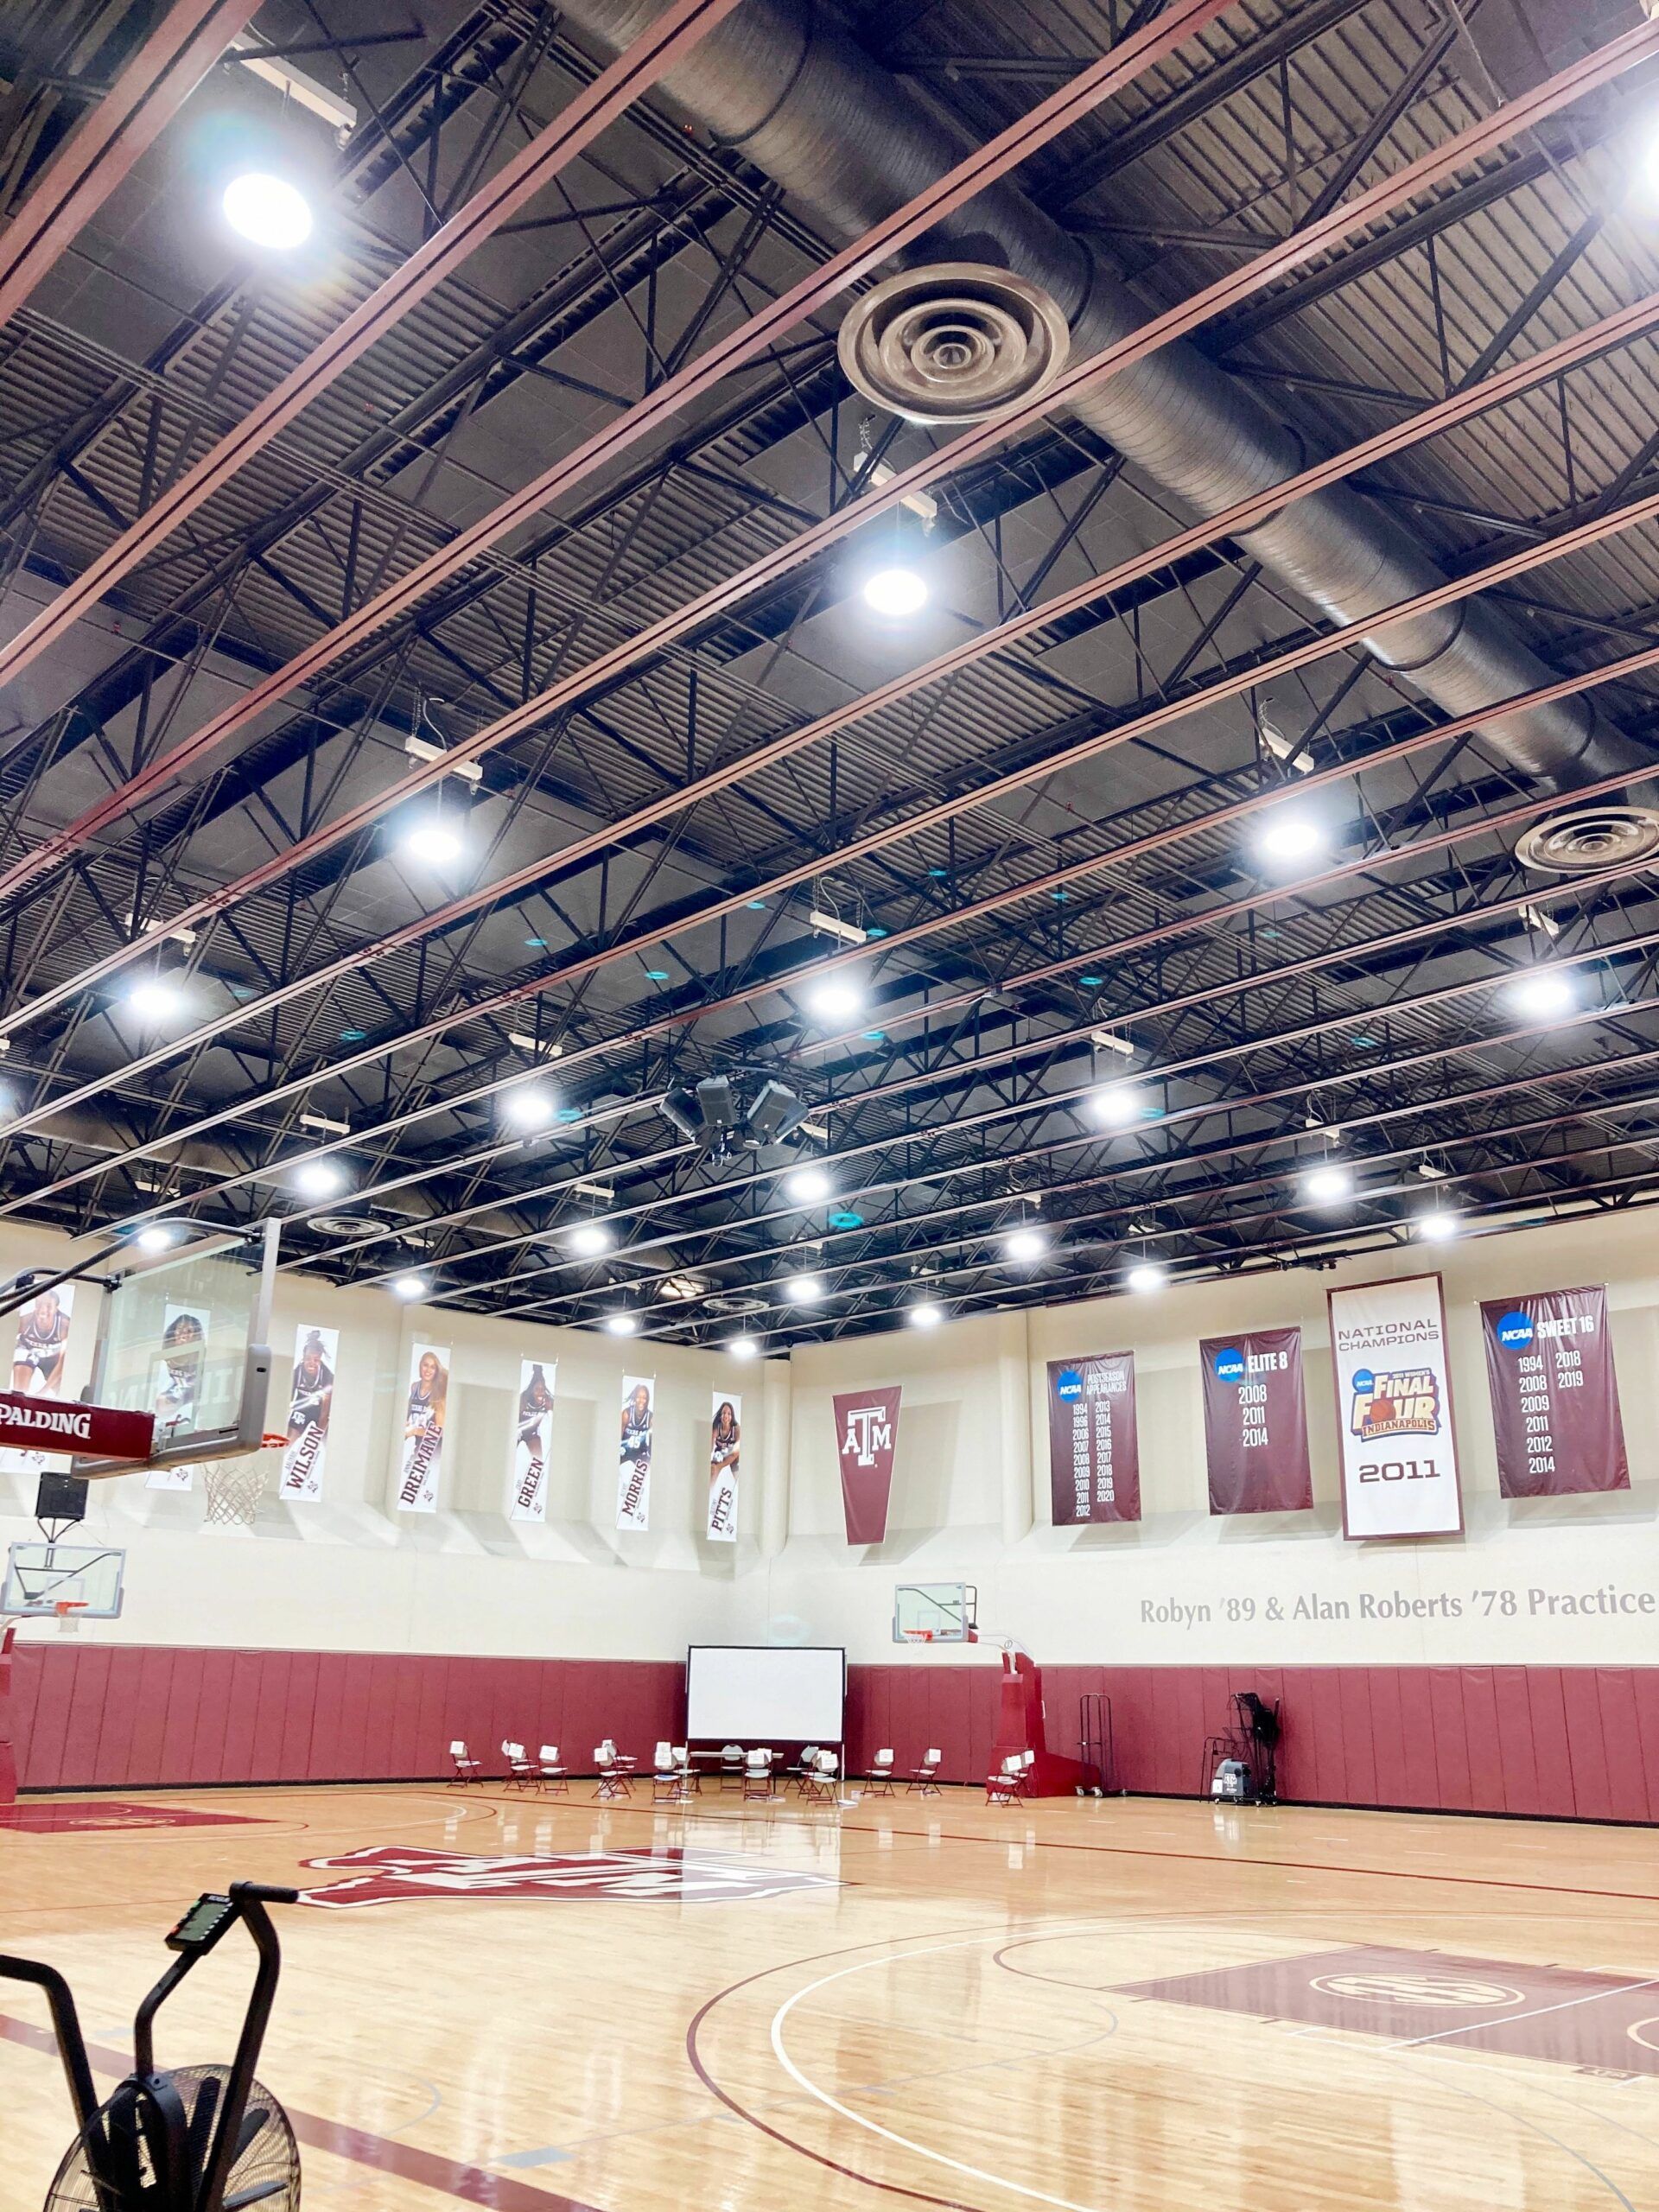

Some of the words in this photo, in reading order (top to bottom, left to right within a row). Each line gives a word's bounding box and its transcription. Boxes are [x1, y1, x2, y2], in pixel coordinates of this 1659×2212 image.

[1338, 1319, 1437, 1340] NATIONAL
[1502, 1328, 1533, 1341] NCAA
[1537, 1317, 1577, 1338] SWEET
[1579, 1315, 1594, 1333] 16
[1338, 1331, 1439, 1351] CHAMPIONS
[1248, 1352, 1277, 1373] ELITE
[1279, 1351, 1288, 1370] 8
[1517, 1355, 1543, 1373] 1994
[1555, 1350, 1581, 1369] 2018
[1217, 1363, 1243, 1375] NCAA
[1374, 1374, 1433, 1400] FINAL
[1519, 1375, 1548, 1393] 2008
[1558, 1370, 1584, 1389] 2019
[1060, 1384, 1081, 1395] NCAA
[1238, 1384, 1268, 1404] 2008
[1073, 1403, 1088, 1415] 1994
[1095, 1401, 1110, 1413] 2013
[1521, 1395, 1549, 1413] 2009
[0, 1403, 91, 1439] PALDING
[1072, 1415, 1088, 1427] 1996
[1096, 1413, 1111, 1426] 2014
[1243, 1406, 1265, 1426] 2011
[1526, 1415, 1548, 1433] 2011
[1072, 1428, 1089, 1440] 2006
[1096, 1426, 1111, 1438] 2015
[1243, 1427, 1268, 1447] 2014
[1362, 1420, 1435, 1437] INDIANAPOLIS
[1073, 1440, 1089, 1453] 2007
[1096, 1439, 1112, 1451] 2016
[1526, 1435, 1553, 1453] 2012
[286, 1425, 324, 1490] WILSON
[400, 1422, 442, 1504] DREIMANE
[1073, 1452, 1090, 1465] 2008
[1096, 1451, 1111, 1464] 2017
[1529, 1456, 1555, 1474] 2014
[1074, 1465, 1090, 1478] 2009
[1096, 1464, 1113, 1477] 2018
[1359, 1460, 1440, 1483] 2011
[518, 1457, 543, 1508] GREEN
[621, 1459, 648, 1516] MORRIS
[1075, 1478, 1090, 1491] 2010
[1097, 1477, 1113, 1490] 2019
[1077, 1491, 1090, 1504] 2011
[1096, 1490, 1115, 1503] 2020
[712, 1487, 732, 1531] PITTS
[1076, 1504, 1090, 1517] 2012
[1141, 1597, 1211, 1630] Robyn
[1219, 1598, 1256, 1621] '89
[1265, 1596, 1284, 1621] &
[1293, 1593, 1350, 1620] Alan
[1359, 1590, 1462, 1618] Roberts
[1471, 1589, 1517, 1616] '78
[1528, 1584, 1656, 1616] Practice
